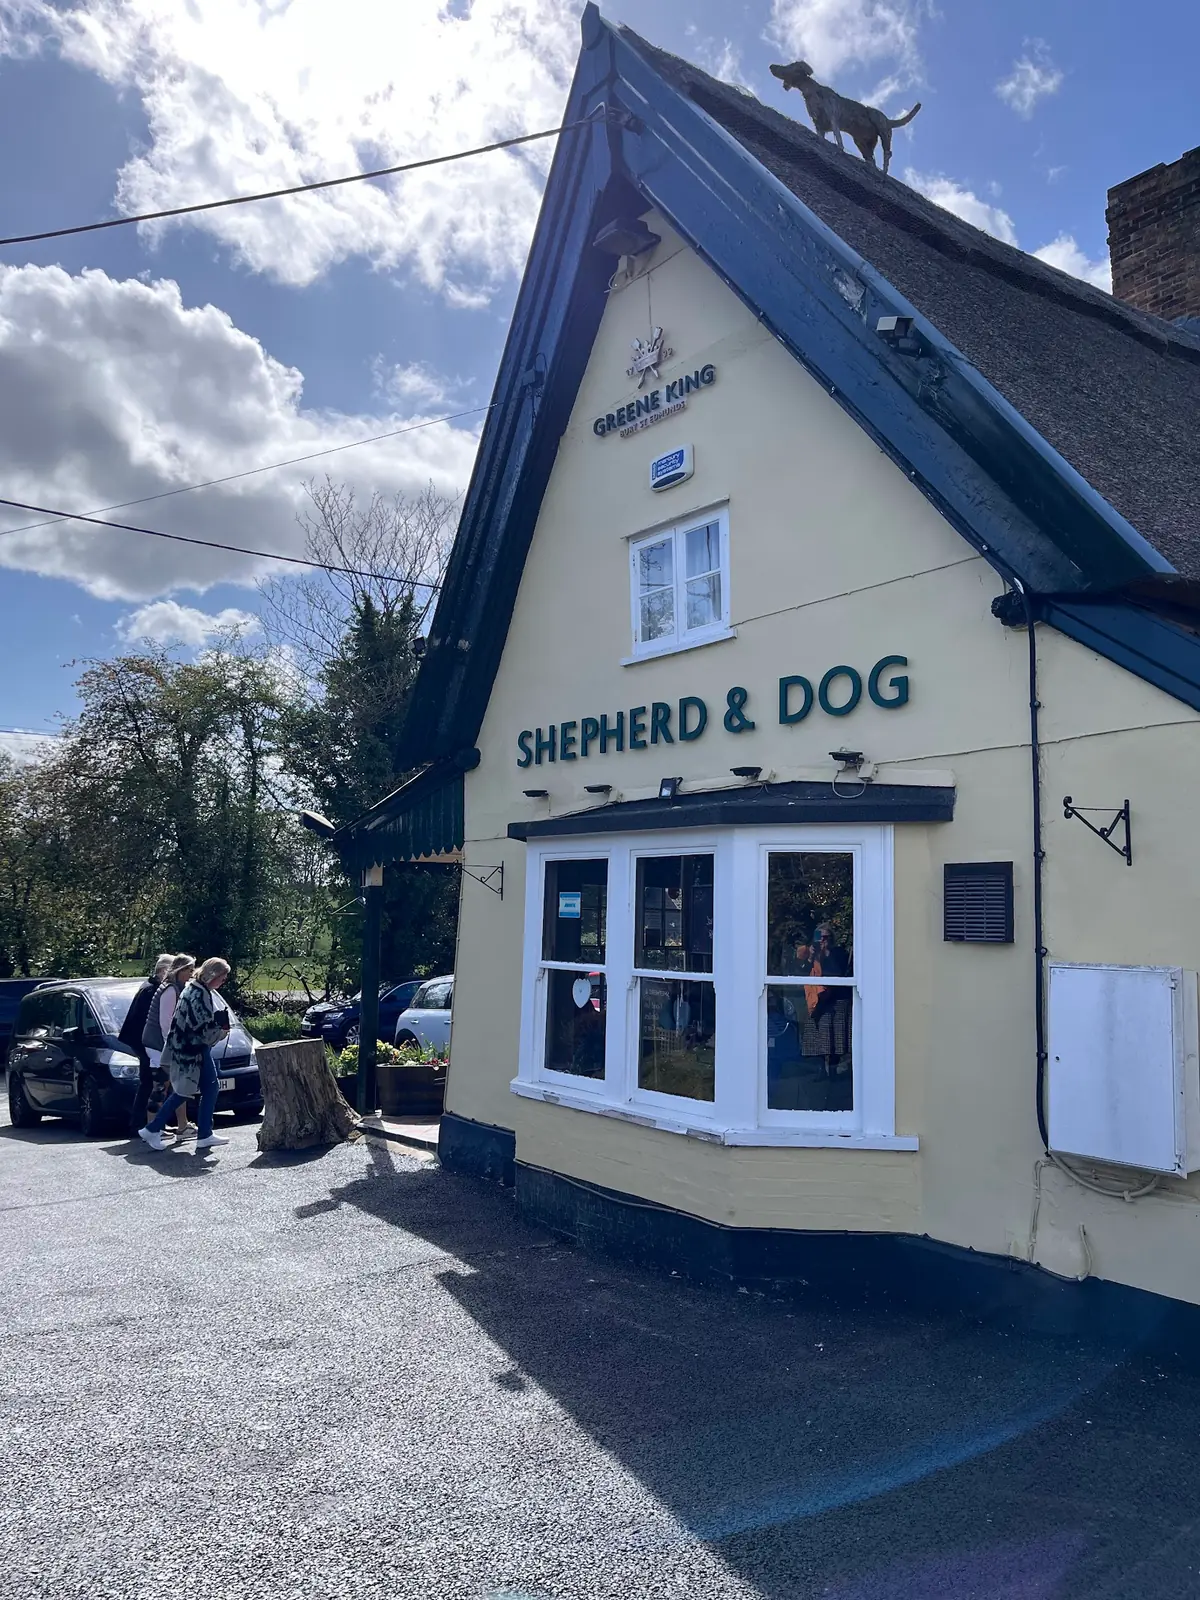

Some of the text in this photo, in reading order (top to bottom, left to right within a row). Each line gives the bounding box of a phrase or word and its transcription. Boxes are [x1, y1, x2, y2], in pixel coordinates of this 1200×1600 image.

[593, 364, 716, 436] GREENE KING
[650, 401, 686, 424] EDMUNDS
[516, 654, 909, 768] SHEPHERD & DOG
